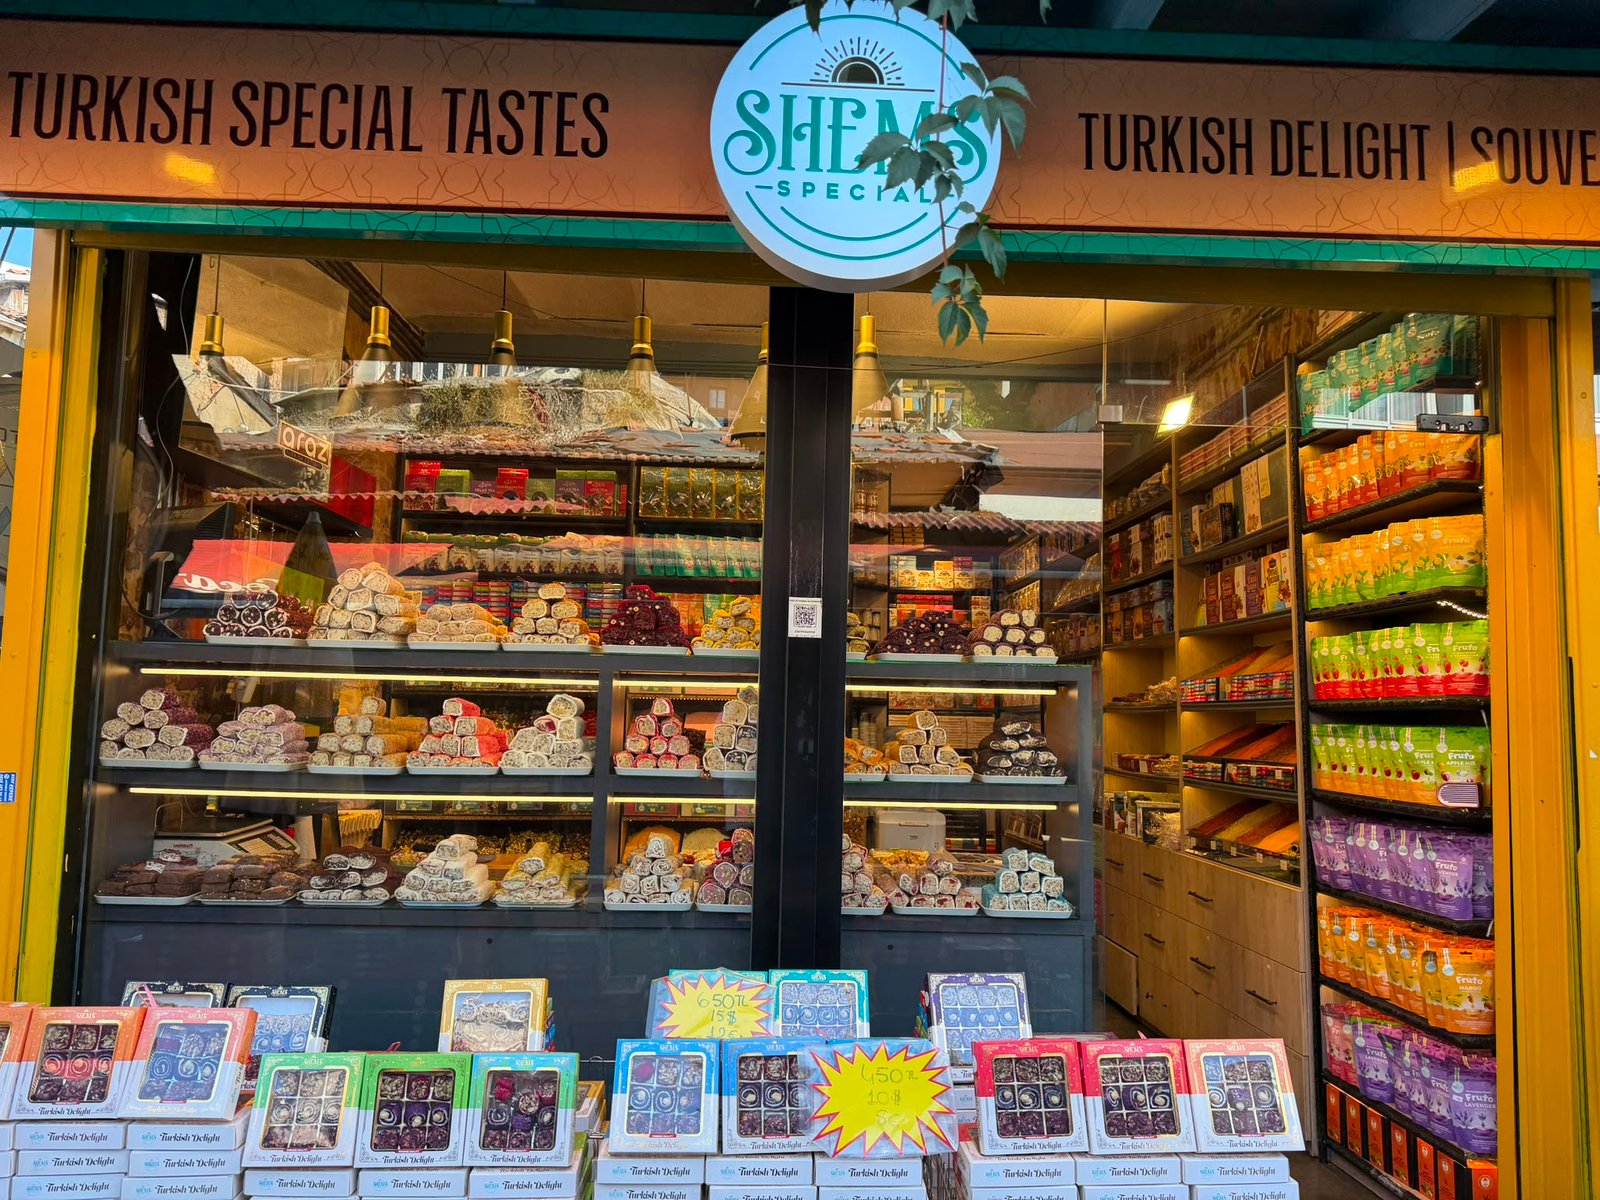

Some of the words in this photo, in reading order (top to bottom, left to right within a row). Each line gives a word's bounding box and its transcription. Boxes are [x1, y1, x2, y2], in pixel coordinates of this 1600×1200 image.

[9, 71, 214, 146] TURKISH
[229, 80, 423, 153] SPECIAL
[441, 87, 610, 159] TASTES
[723, 90, 987, 184] SHEMS
[1078, 112, 1254, 176] TURKISH
[1270, 119, 1430, 181] DELIGHT
[777, 180, 932, 204] SPECIAL
[1456, 976, 1483, 985] Fruto
[1465, 1093, 1494, 1103] Fruto
[38, 1107, 65, 1115] Turkish
[66, 1107, 91, 1116] Delight
[48, 1132, 78, 1141] Turkish
[79, 1132, 108, 1142] Delight
[160, 1132, 190, 1142] Turkish
[191, 1133, 220, 1144] Delight
[750, 1142, 776, 1150] Turkish
[777, 1141, 802, 1150] Delight
[1011, 1142, 1037, 1150] Turkish
[1037, 1142, 1062, 1150] Delight
[51, 1157, 84, 1167] Turkish
[85, 1157, 115, 1167] Delight
[163, 1158, 195, 1168] Turkish
[196, 1158, 226, 1169] Delight
[270, 1154, 296, 1163] Turkish
[297, 1154, 322, 1164] Delight
[382, 1156, 408, 1164] Turkish
[409, 1156, 434, 1165] Delight
[490, 1155, 516, 1163] Turkish
[517, 1155, 541, 1164] Delight
[630, 1166, 661, 1176] Turkish
[662, 1167, 691, 1177] Delight
[738, 1167, 769, 1176] Turkish
[770, 1167, 799, 1178] Delight
[848, 1168, 879, 1177] Turkish
[880, 1168, 909, 1179] Delight
[1003, 1168, 1033, 1178] Turkish
[1034, 1168, 1062, 1179] Delight
[1109, 1167, 1139, 1176] Turkish
[1140, 1167, 1168, 1177] Delight
[1217, 1166, 1247, 1176] Turkish
[1247, 1166, 1276, 1177] Delight
[45, 1182, 78, 1192] Turkish
[79, 1182, 110, 1193] Delight
[155, 1184, 187, 1194] Turkish
[188, 1184, 218, 1195] Delight
[276, 1178, 307, 1188] Turkish
[307, 1179, 335, 1190] Delight
[391, 1179, 421, 1188] Turkish
[422, 1179, 451, 1190] Delight
[502, 1180, 533, 1190] Turkish
[533, 1180, 563, 1191] Delight
